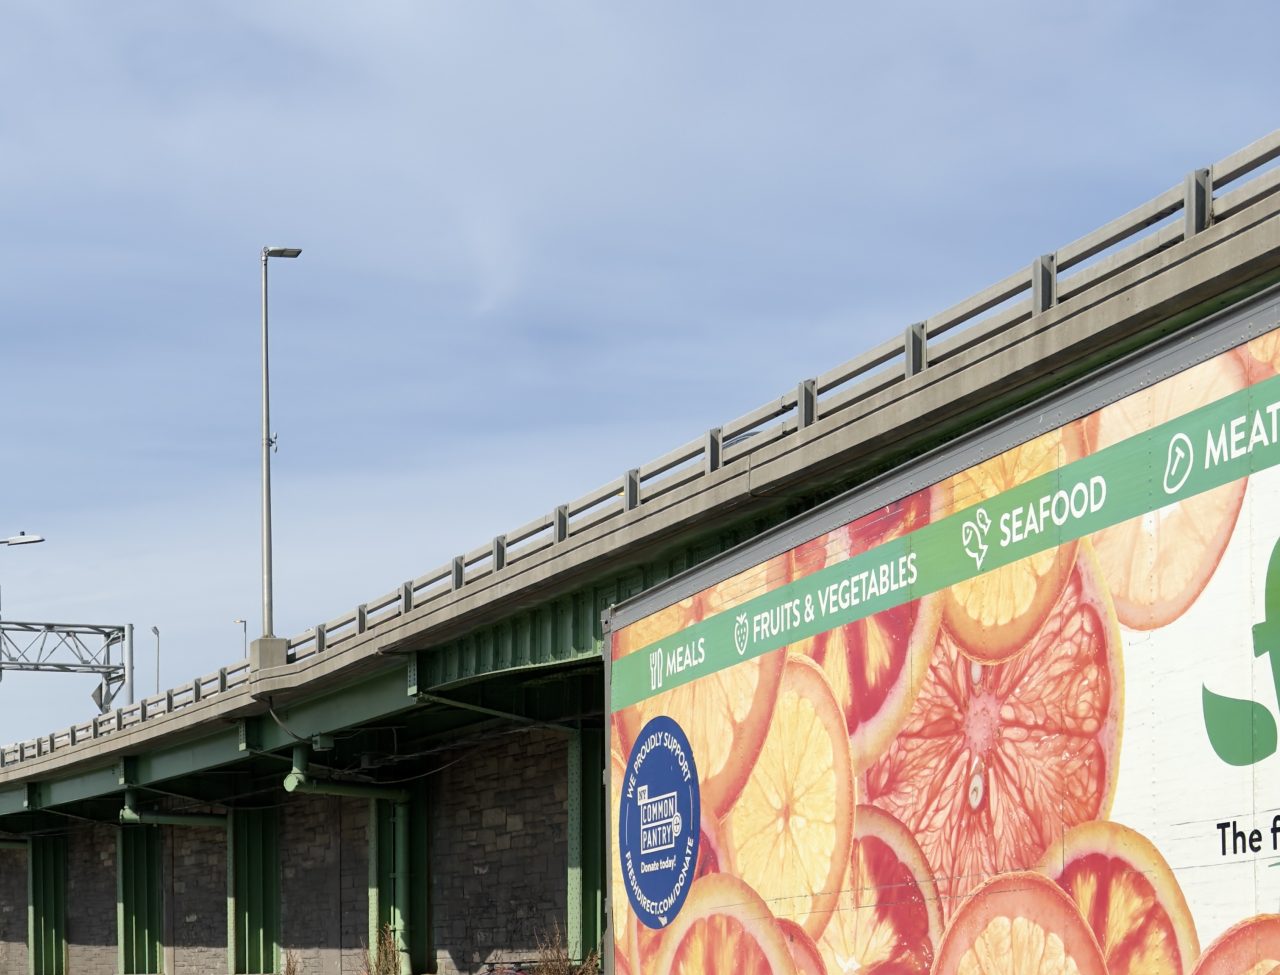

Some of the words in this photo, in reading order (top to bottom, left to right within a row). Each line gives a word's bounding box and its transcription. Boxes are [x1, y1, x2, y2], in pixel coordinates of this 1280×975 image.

[1000, 475, 1107, 547] SEAFOOD
[753, 598, 801, 643] FRUITS
[804, 594, 815, 623] &
[818, 552, 918, 617] VEGETABLES
[666, 637, 705, 677] MEALS
[626, 773, 637, 798] WE
[634, 731, 663, 774] PROUDLY
[663, 732, 691, 782] SUPPORT
[638, 789, 647, 801] NY
[642, 798, 674, 824] COMMON
[642, 824, 672, 849] PANTRY
[1216, 820, 1263, 856] The
[625, 836, 694, 915] FRESHDIRECT.COM/DONATE
[640, 860, 660, 874] Donate
[659, 854, 677, 871] today!
